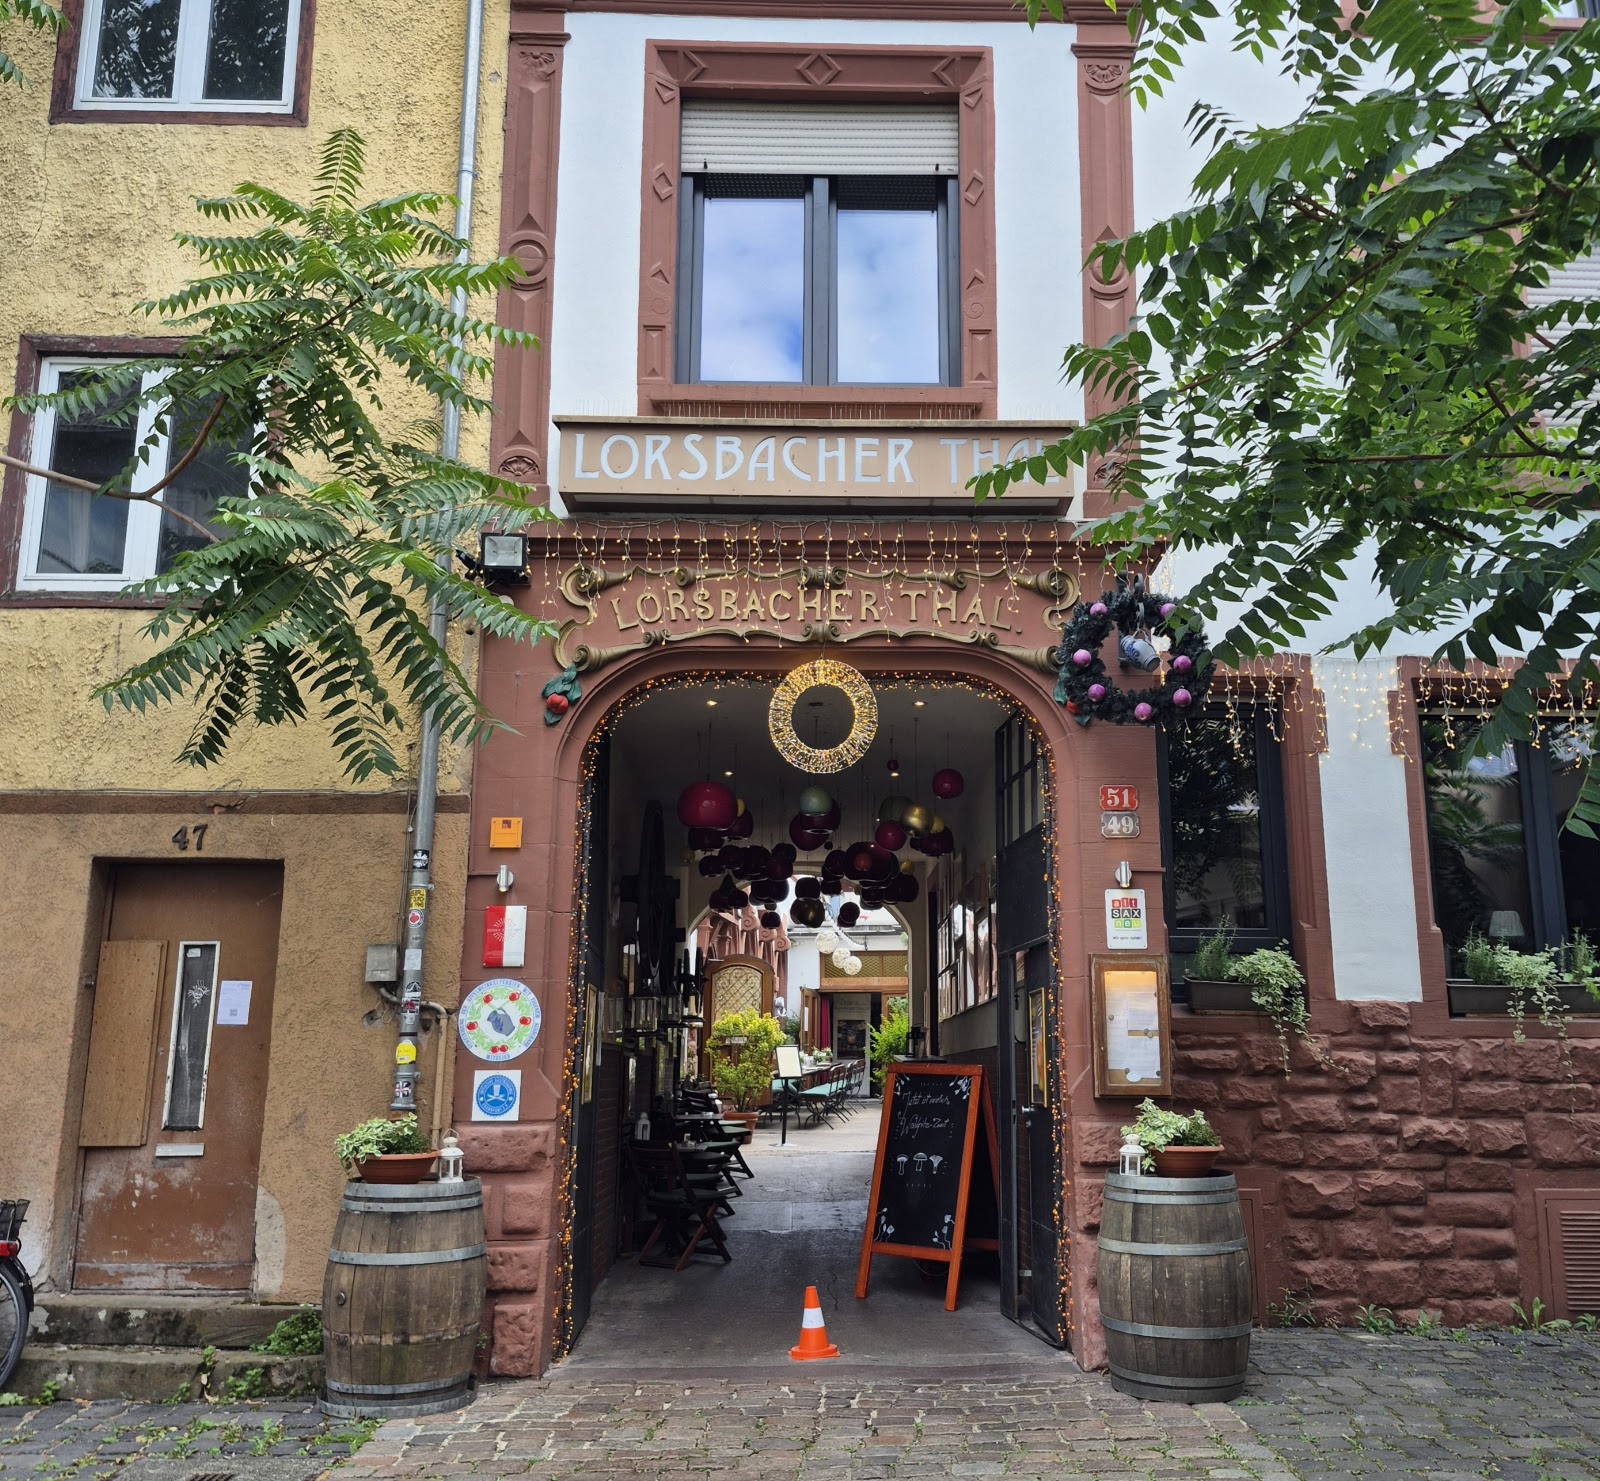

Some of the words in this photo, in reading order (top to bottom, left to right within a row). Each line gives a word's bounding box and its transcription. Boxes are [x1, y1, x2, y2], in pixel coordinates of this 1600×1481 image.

[574, 433, 914, 483] LORSBACHER
[610, 588, 880, 631] LORSBACHER
[1107, 788, 1132, 808] 51
[1107, 815, 1134, 835] 49
[171, 824, 208, 851] 47
[1112, 908, 1141, 918] SAX
[1113, 898, 1137, 908] alt
[1115, 919, 1141, 928] neu
[522, 987, 532, 996] MIT
